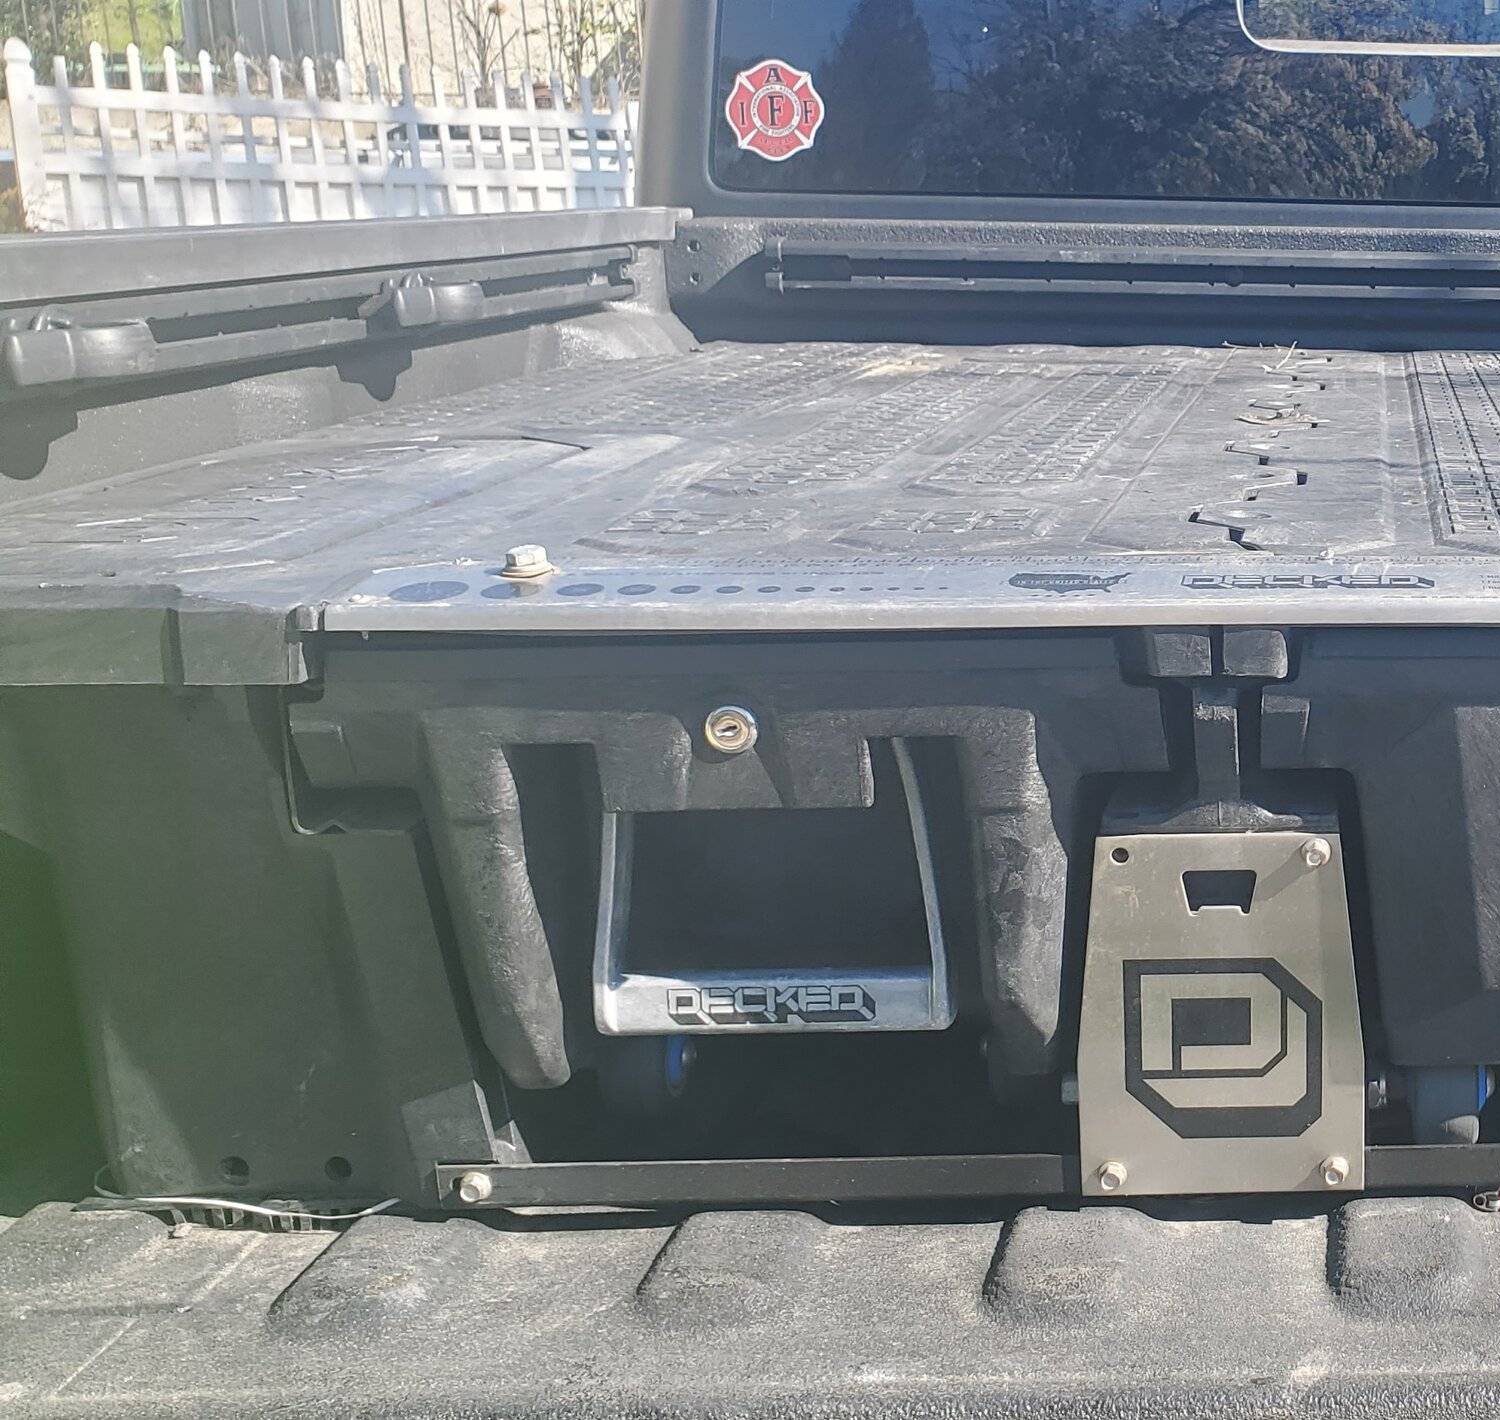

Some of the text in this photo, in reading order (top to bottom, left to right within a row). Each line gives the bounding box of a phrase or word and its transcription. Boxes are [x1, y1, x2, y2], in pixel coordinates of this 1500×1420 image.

[764, 67, 783, 83] A
[739, 95, 816, 126] I F F
[1181, 574, 1435, 589] DECKED
[667, 984, 876, 1026] DECKED
[1122, 957, 1323, 1140] D
